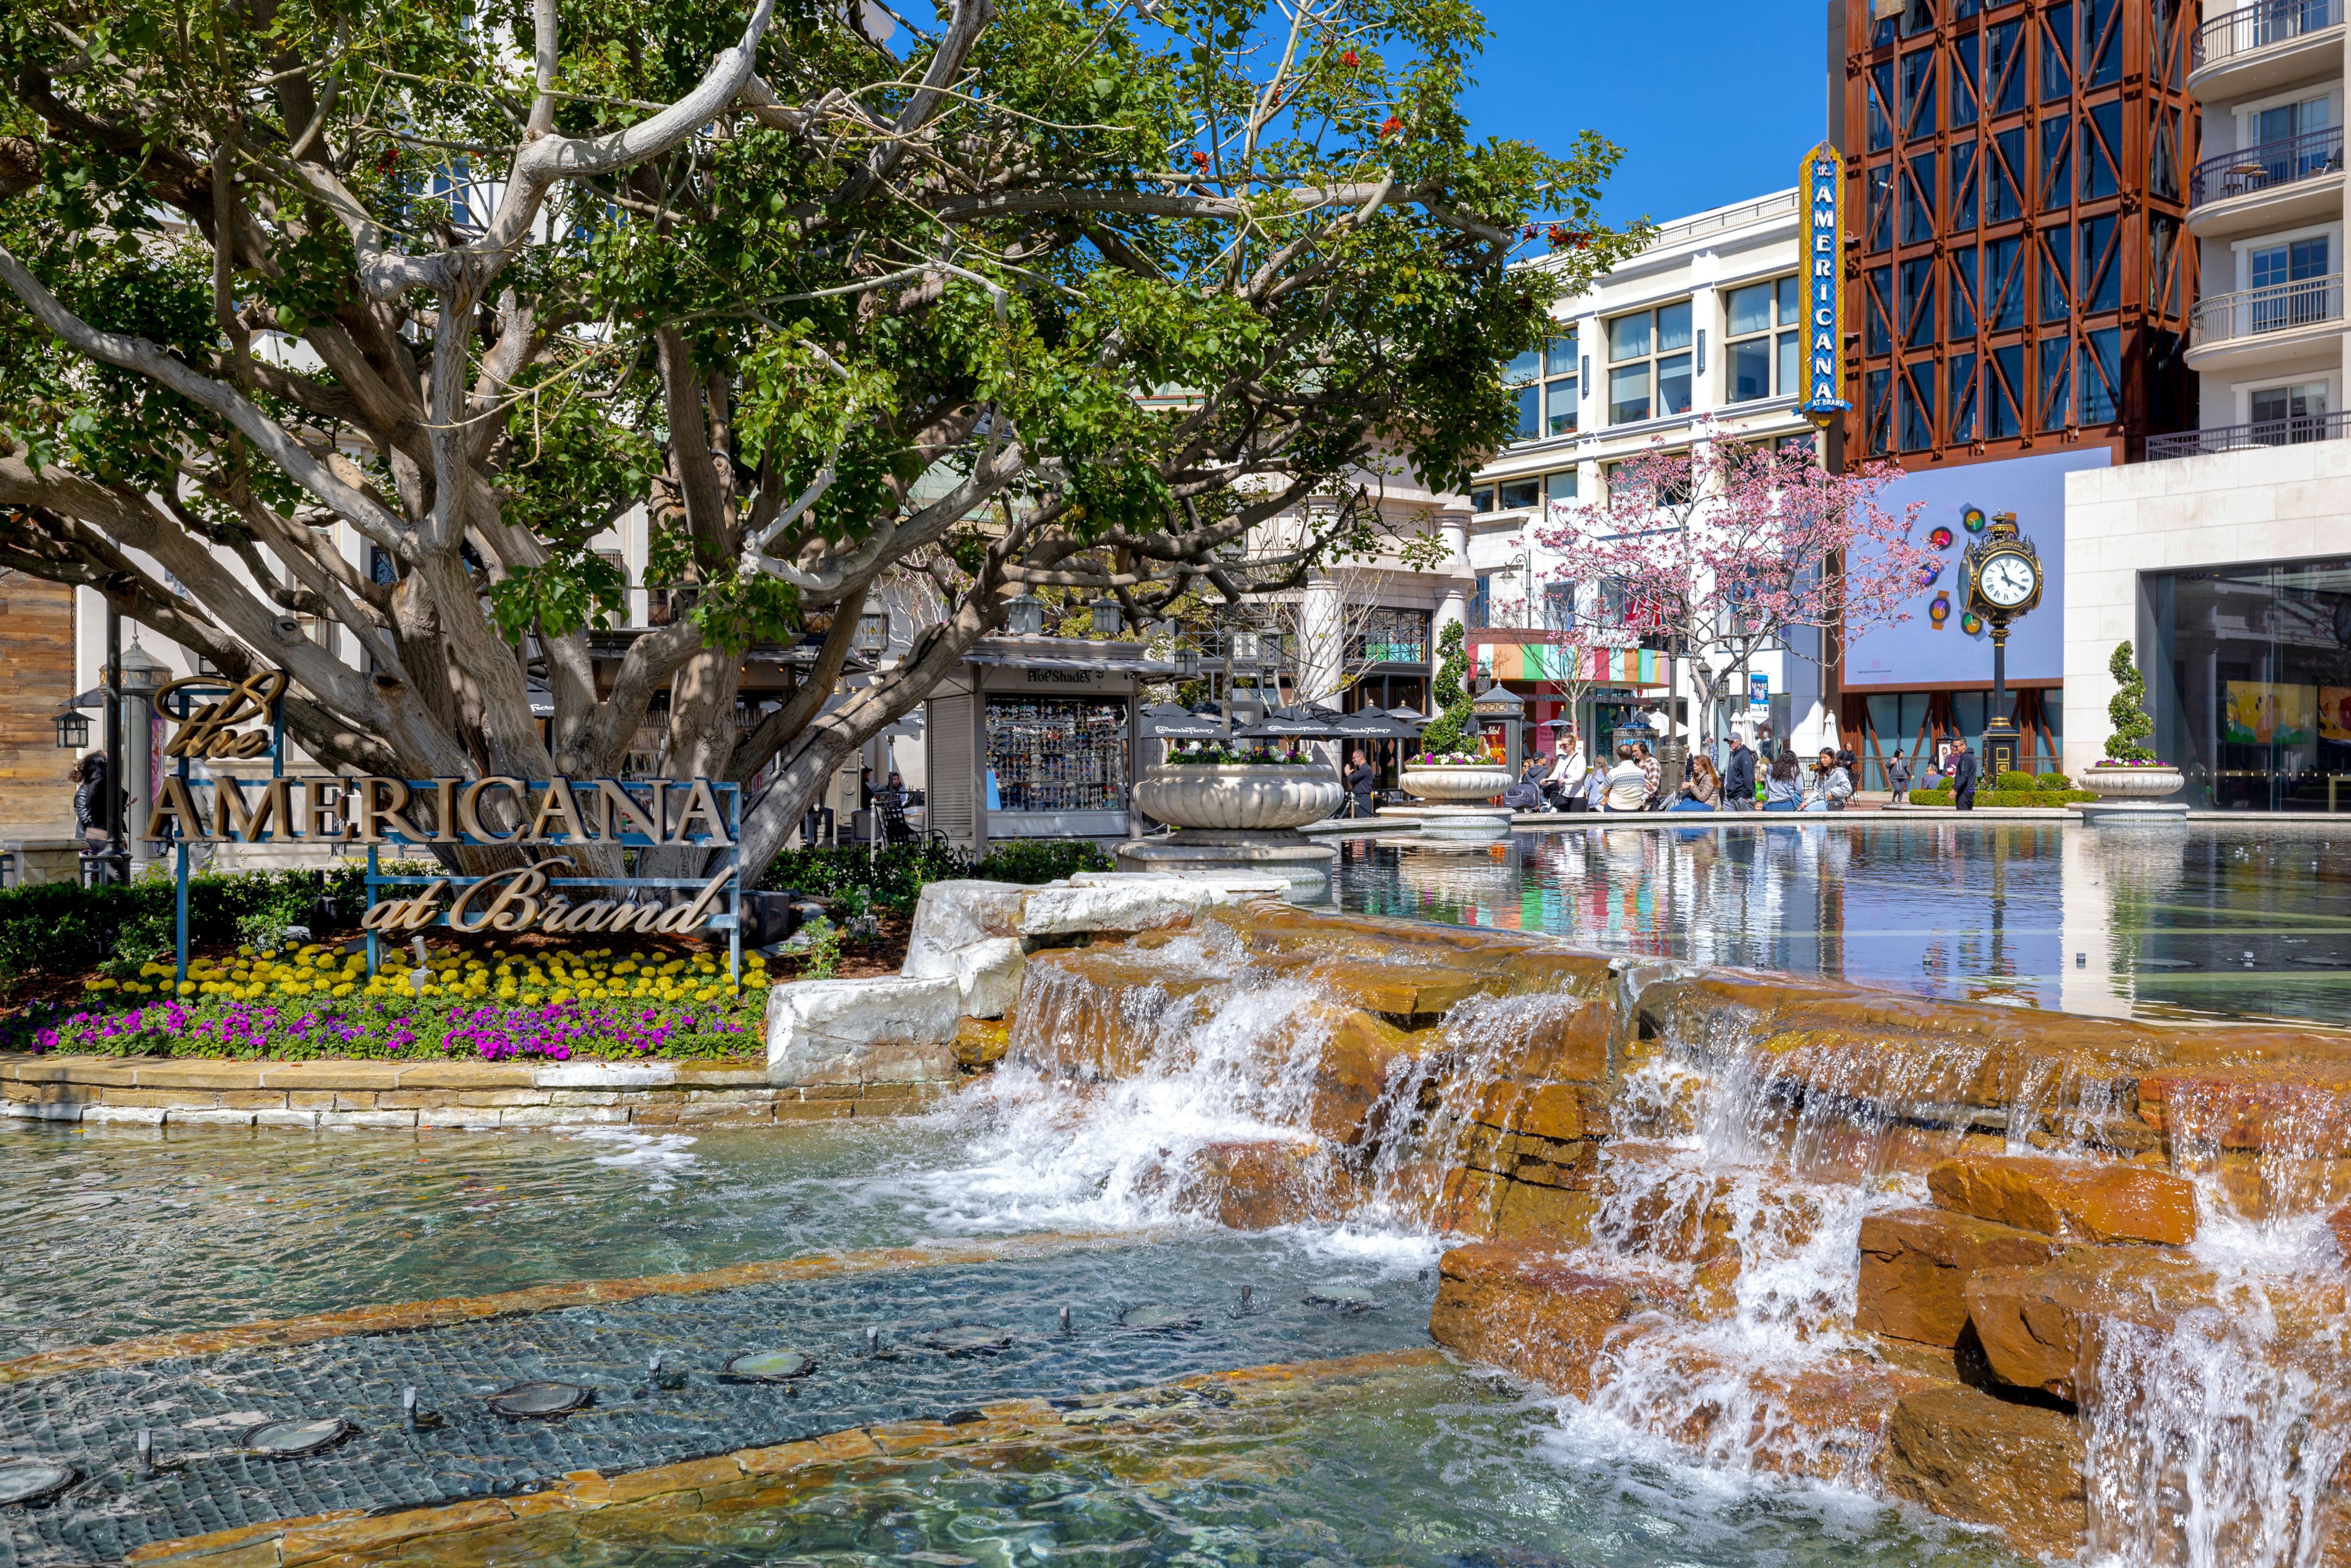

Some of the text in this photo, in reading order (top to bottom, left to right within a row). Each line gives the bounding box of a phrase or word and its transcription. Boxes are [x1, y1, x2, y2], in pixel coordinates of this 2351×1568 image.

[1814, 185, 1834, 399] AMERICANA
[1822, 398, 1845, 407] BRAND
[1052, 670, 1091, 683] Shades
[1579, 695, 1607, 703] CUPCAKE
[1610, 696, 1623, 704] ATM
[1488, 726, 1501, 735] Idol
[137, 775, 735, 845] AMERICANA
[360, 856, 738, 934] at Brand
